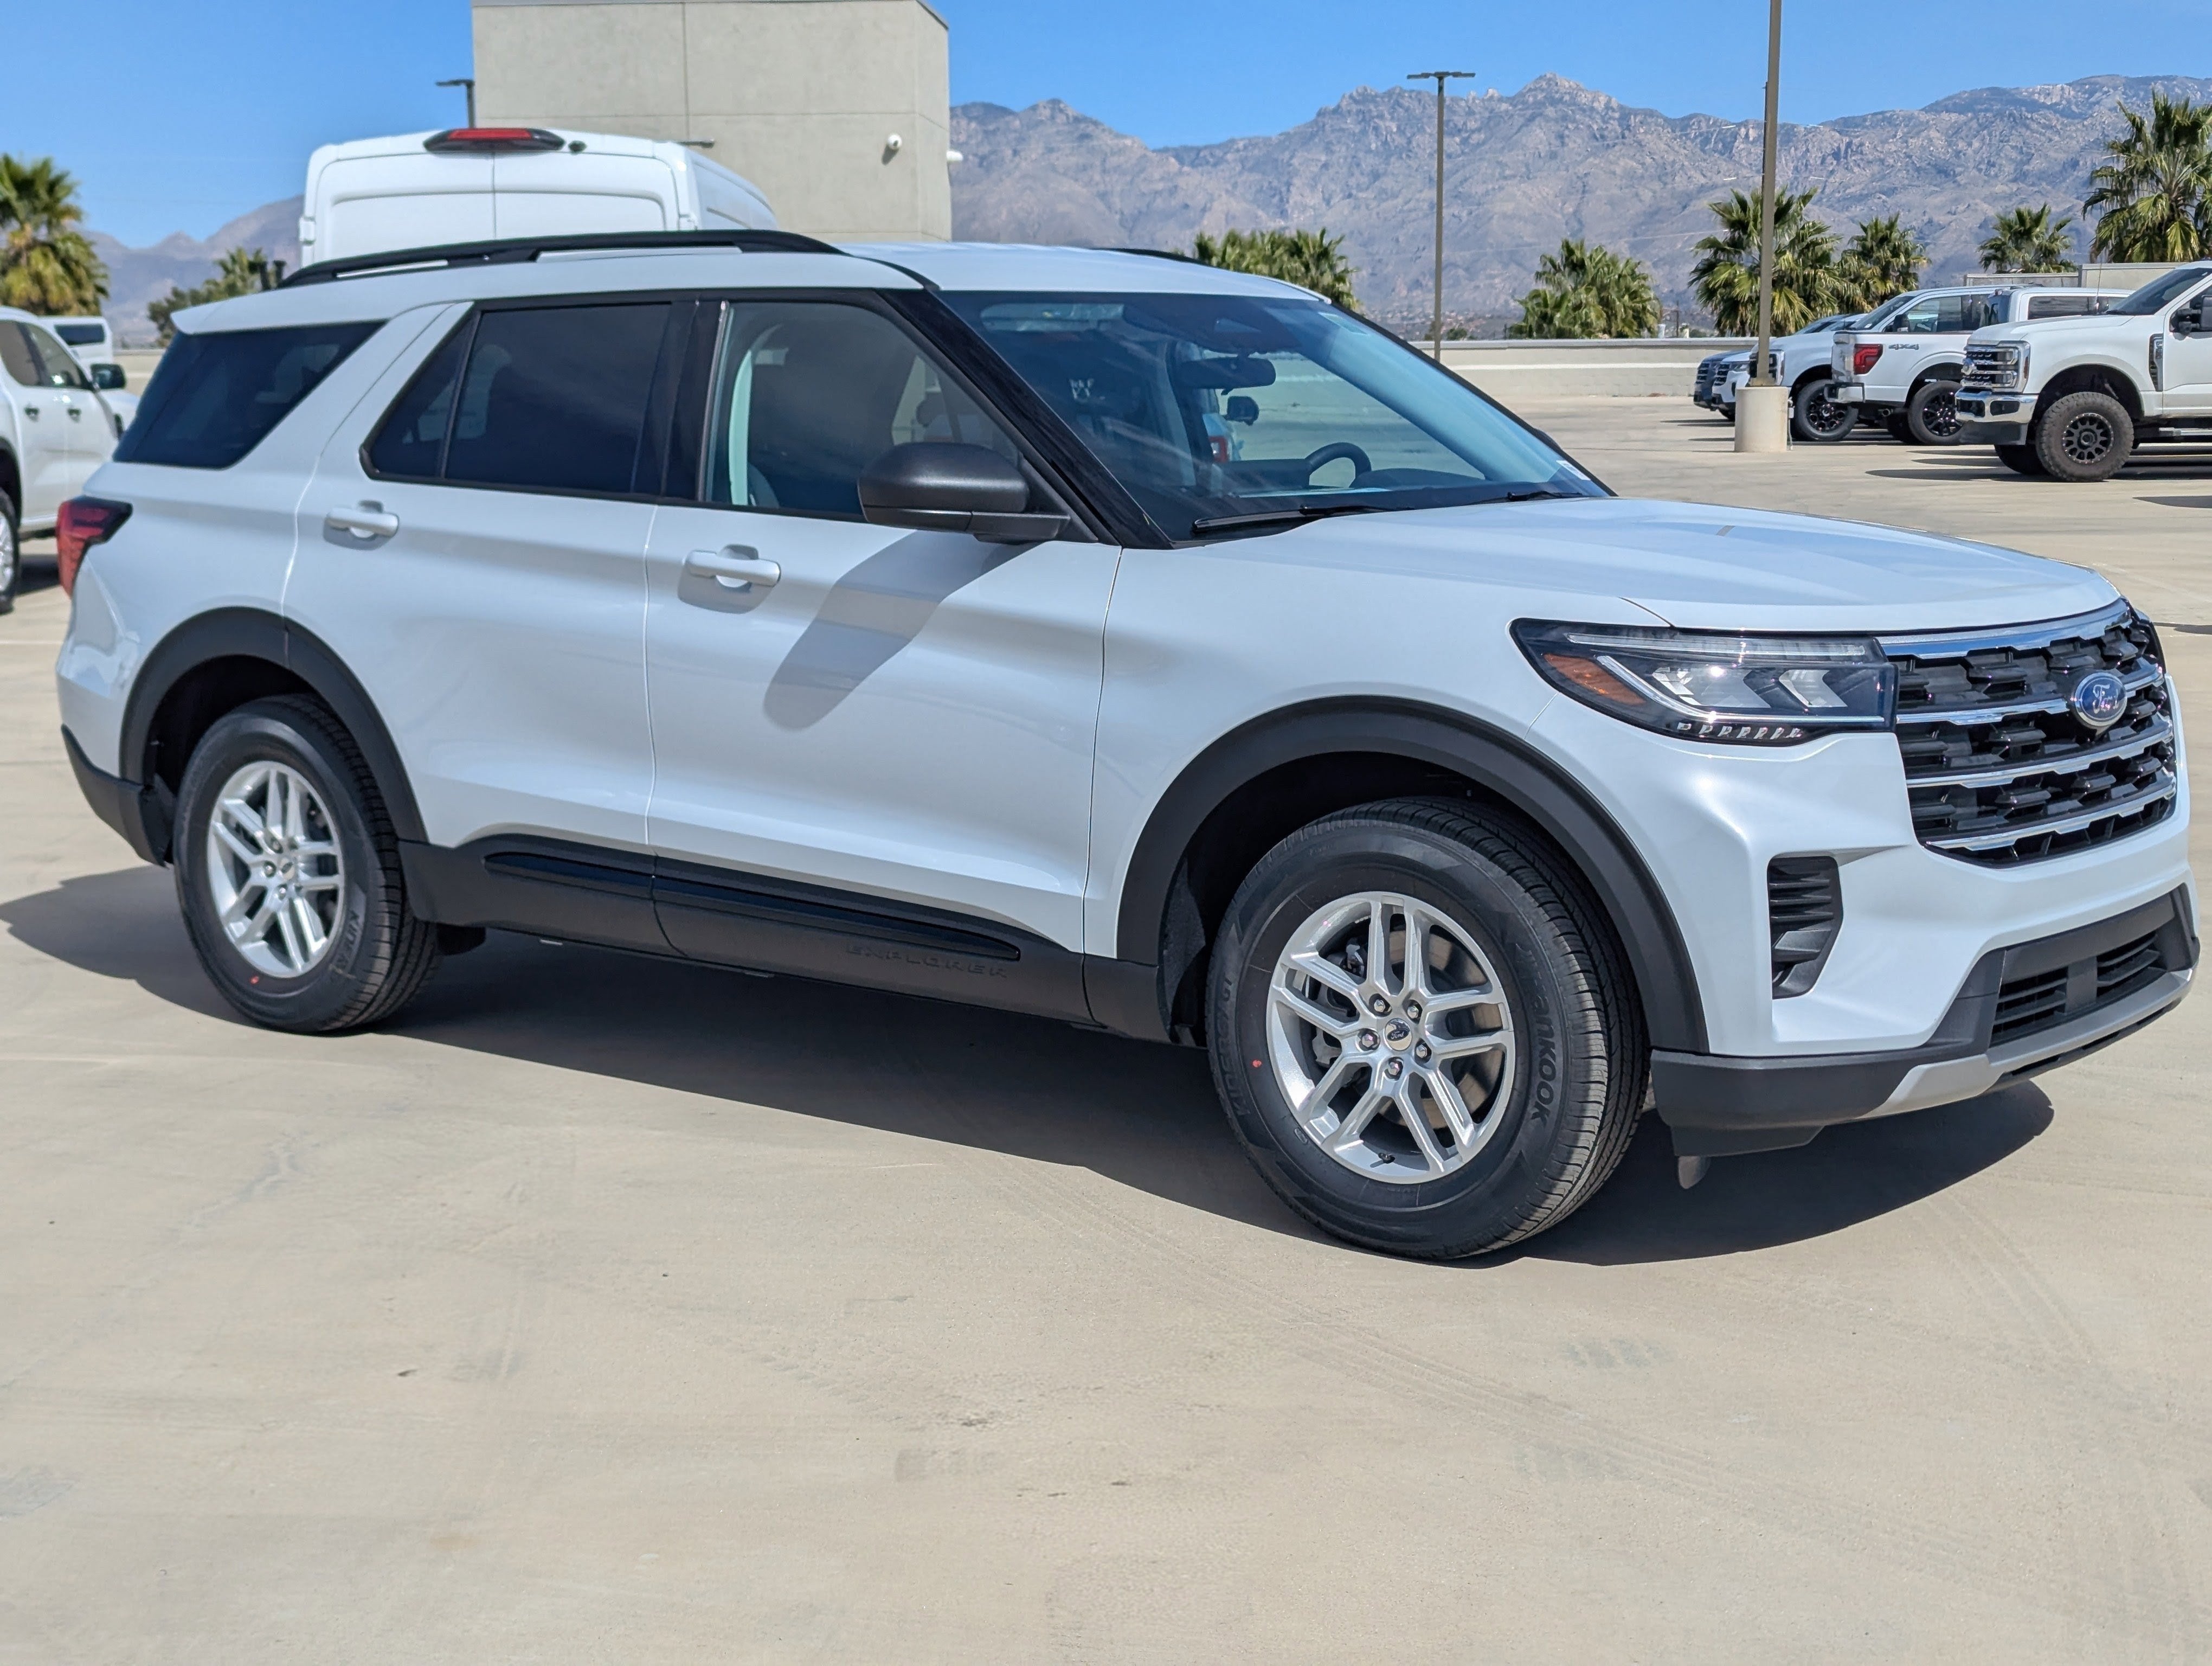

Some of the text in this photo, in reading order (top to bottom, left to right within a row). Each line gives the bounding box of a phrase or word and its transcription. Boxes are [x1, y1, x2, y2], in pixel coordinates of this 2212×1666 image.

[2093, 684, 2119, 714] Ford
[846, 946, 1007, 978] EXPLORER
[1391, 1031, 1404, 1040] Ford
